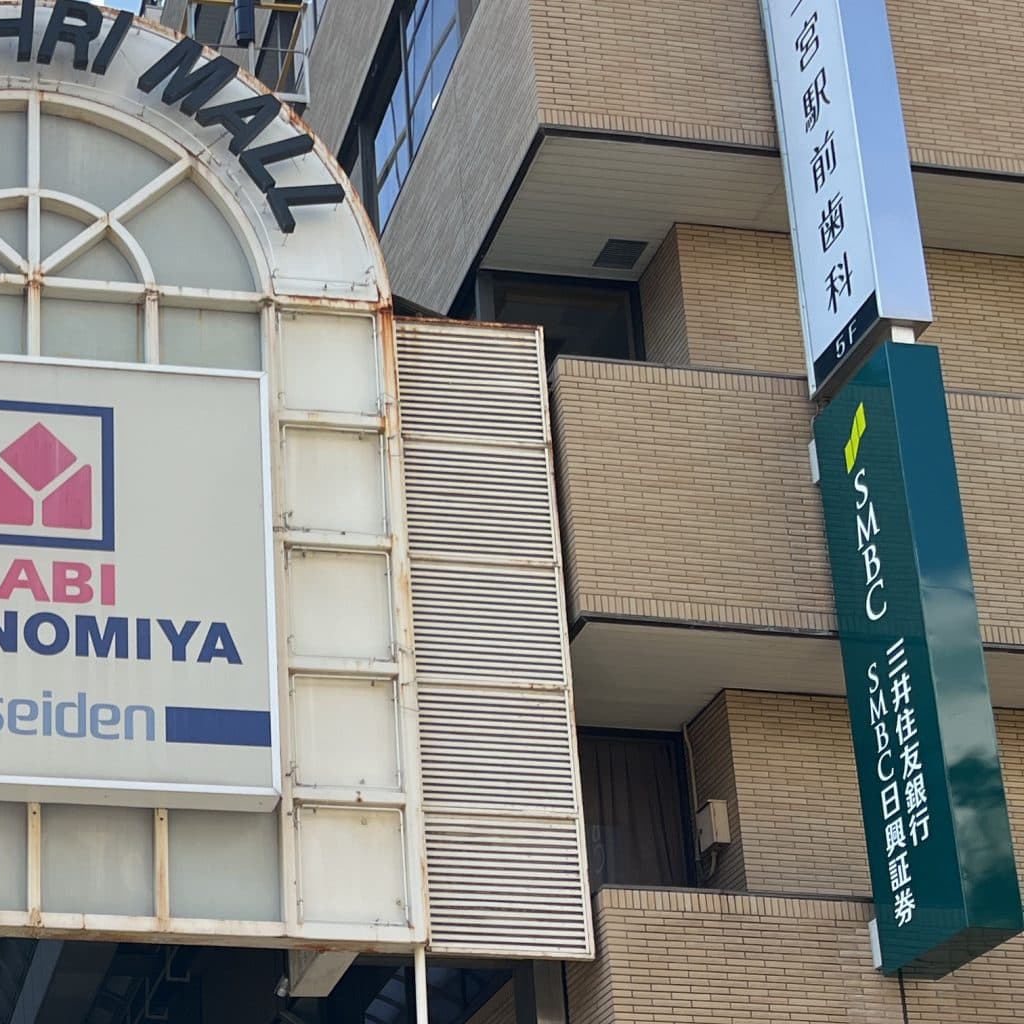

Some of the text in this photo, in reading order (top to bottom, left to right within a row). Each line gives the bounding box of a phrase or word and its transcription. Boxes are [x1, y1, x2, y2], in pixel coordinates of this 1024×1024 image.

[137, 37, 346, 234] MALL
[790, 0, 854, 314] 宮駅前歯科
[854, 468, 887, 621] SMBC
[867, 662, 916, 928] SMBC日興証券
[886, 637, 931, 847] 三井住友銀行
